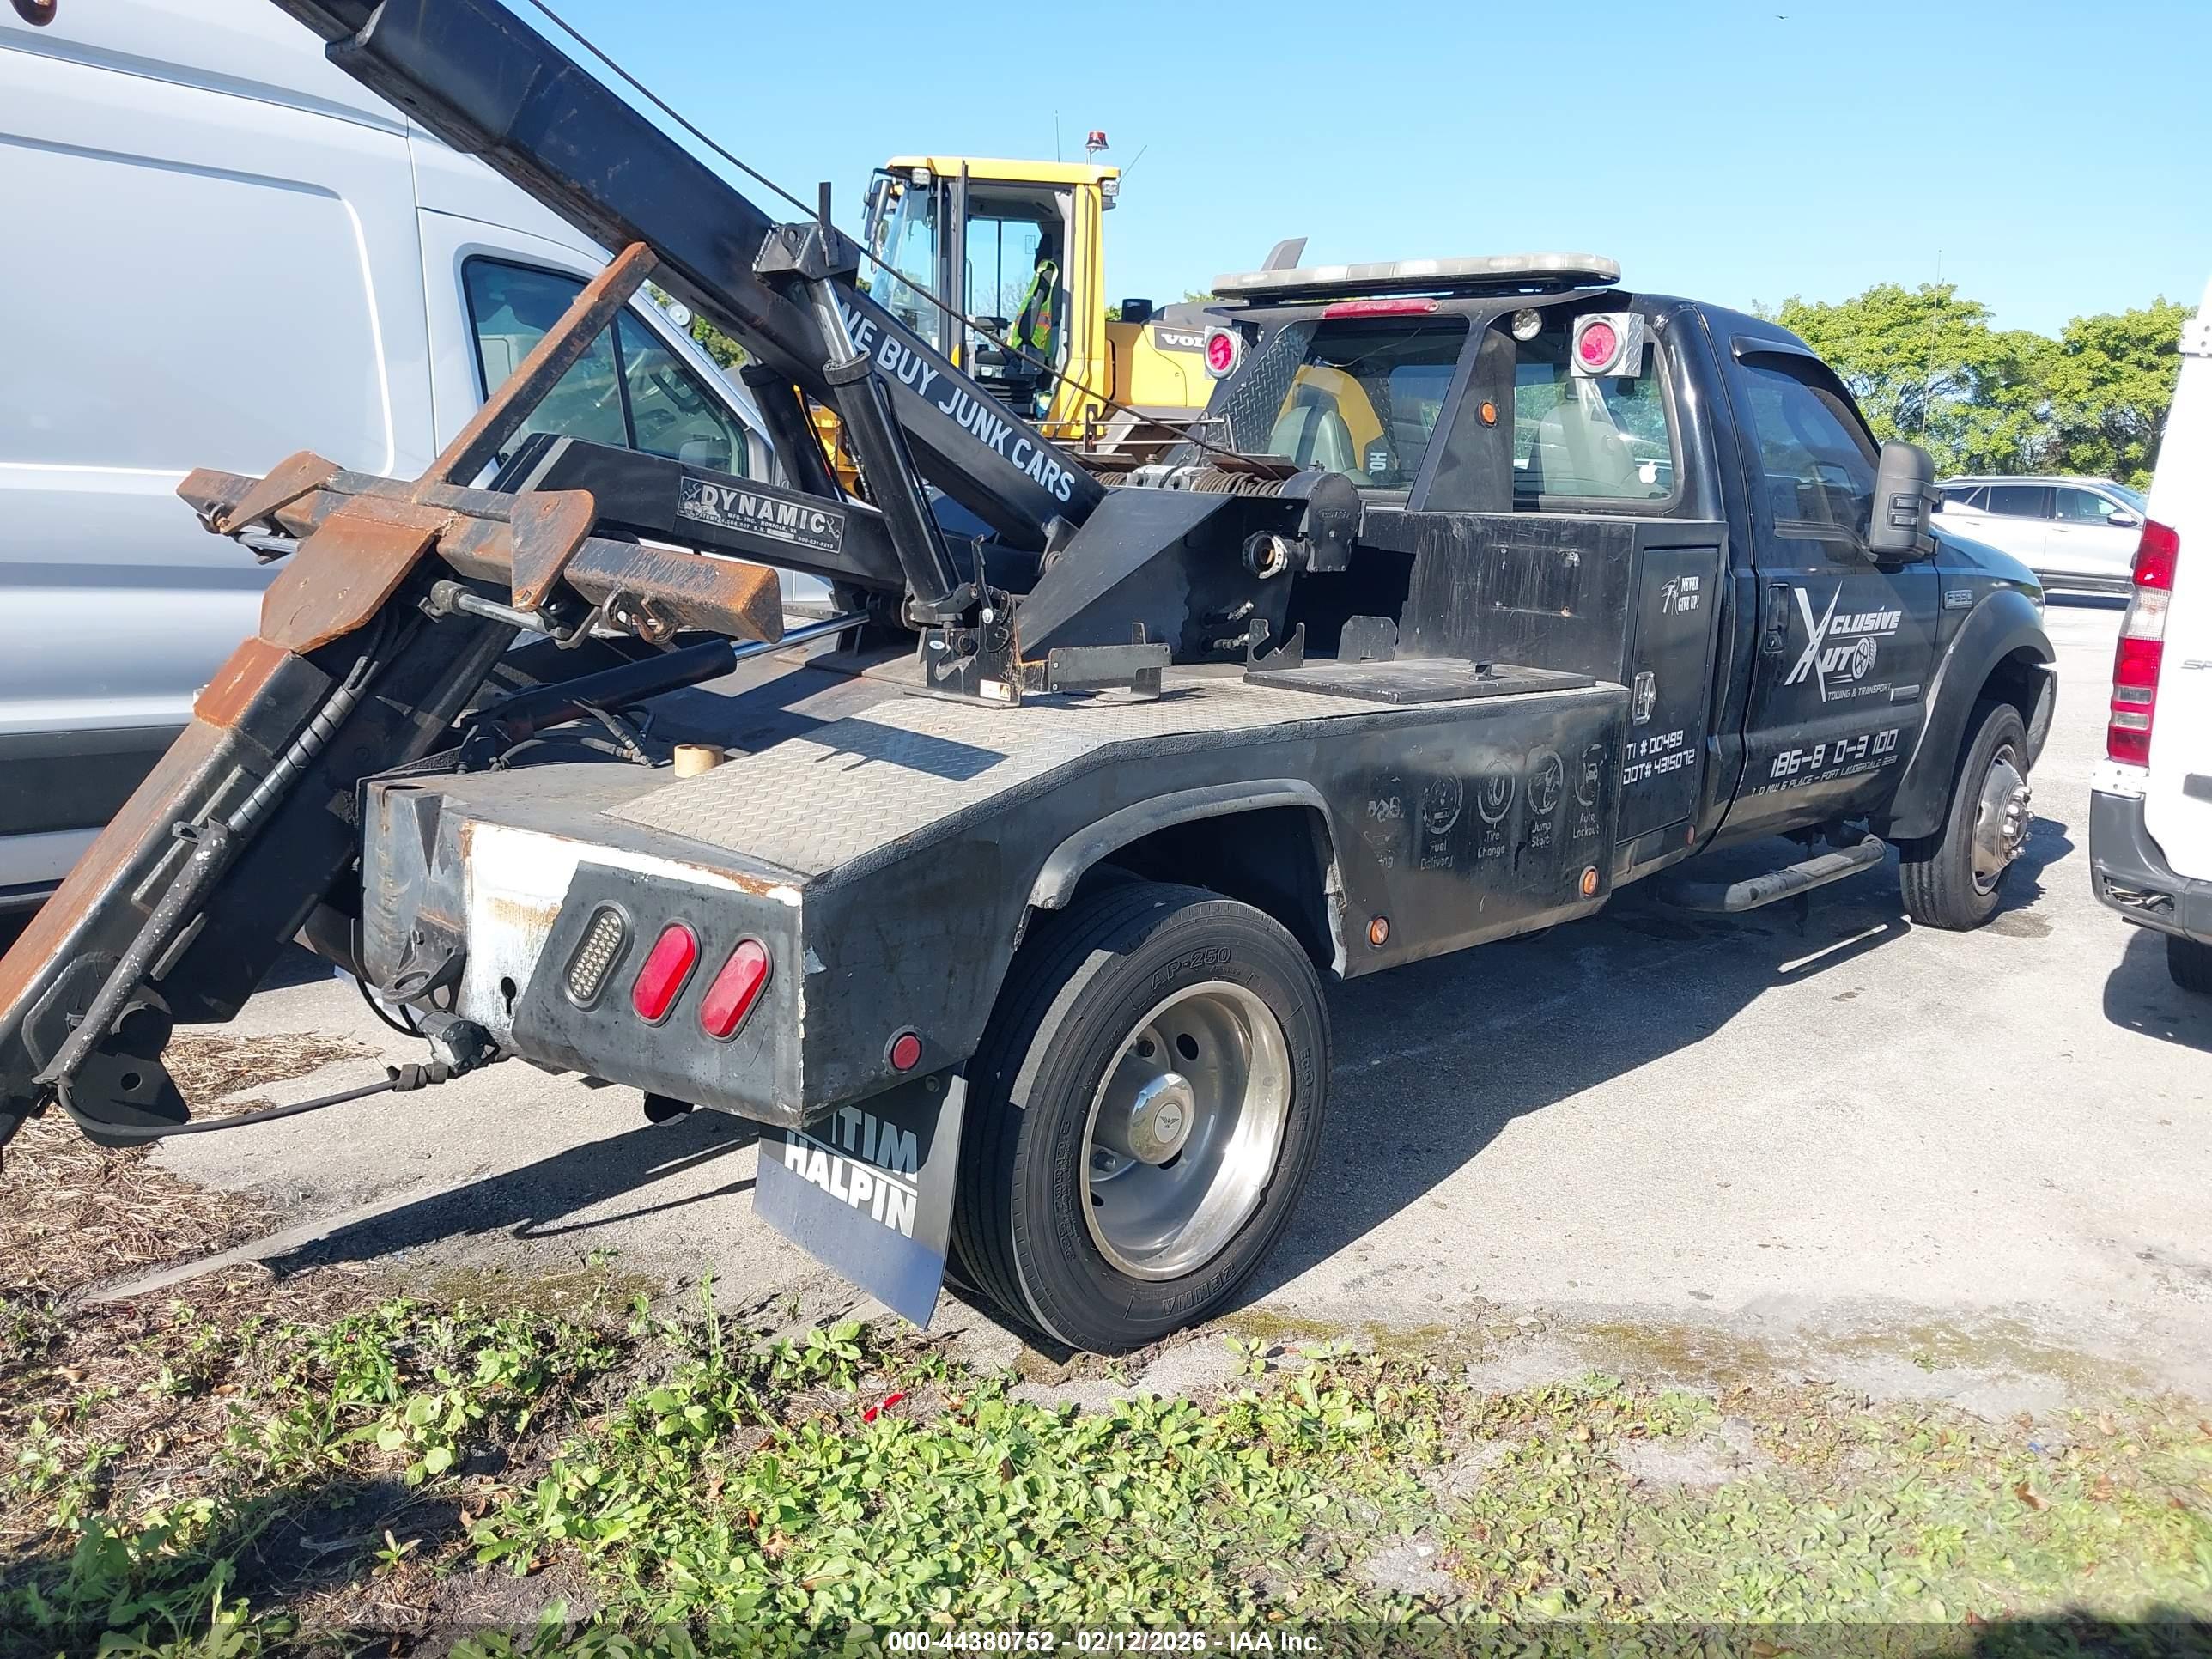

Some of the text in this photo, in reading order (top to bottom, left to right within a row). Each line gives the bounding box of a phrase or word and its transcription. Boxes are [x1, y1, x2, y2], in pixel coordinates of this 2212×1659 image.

[1161, 333, 1205, 348] VOL
[877, 334, 939, 396] BUY
[938, 388, 1012, 456] JUNK
[1012, 438, 1075, 502] CARS
[700, 484, 826, 533] DYNAMIC
[760, 520, 788, 532] NORFOLK,
[790, 526, 797, 534] VA
[1680, 576, 1699, 592] NEVER
[1678, 594, 1700, 611] GIVE UP!
[1827, 683, 1892, 702] TOWING & TRANSPORT
[1531, 821, 1552, 834] Jump
[1486, 830, 1500, 842] Tire
[1531, 835, 1551, 848] Start
[1477, 844, 1505, 859] Change
[1149, 946, 1232, 992] AP-250
[839, 1105, 918, 1185] TIM
[784, 1129, 918, 1239] HALPIN
